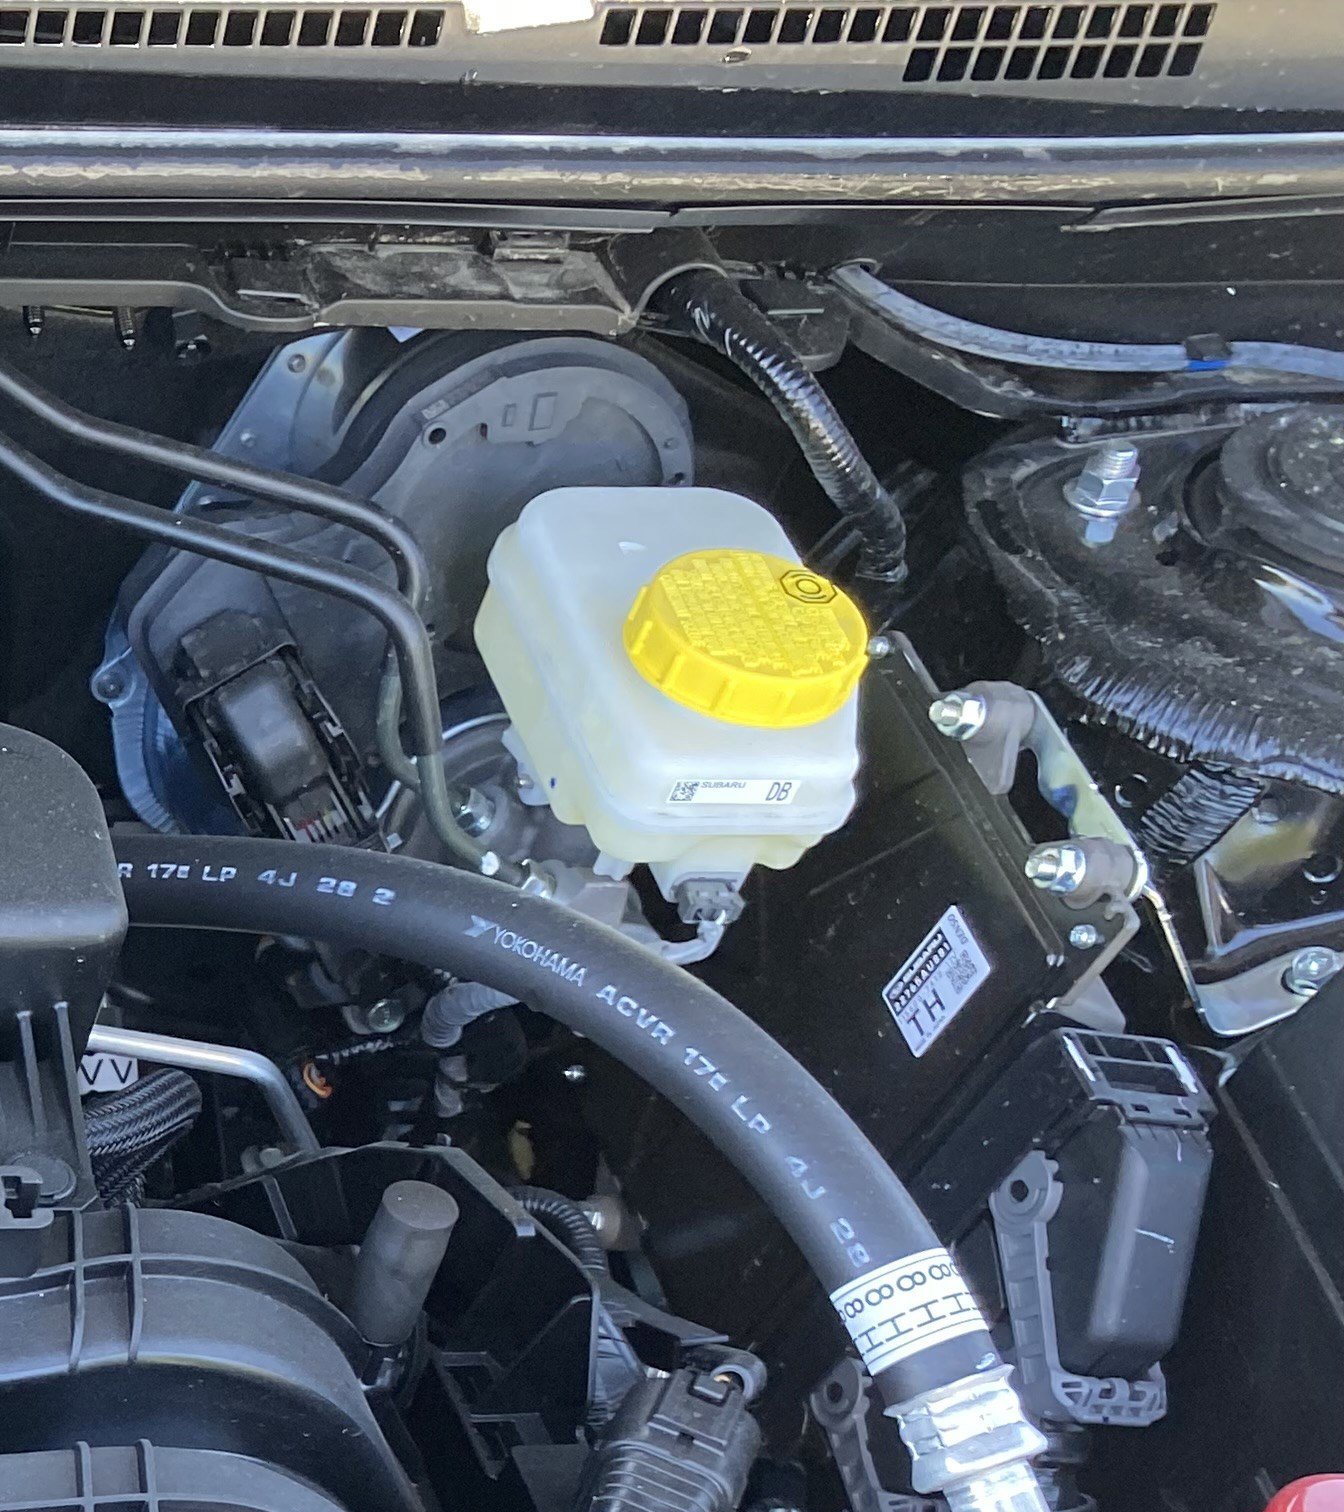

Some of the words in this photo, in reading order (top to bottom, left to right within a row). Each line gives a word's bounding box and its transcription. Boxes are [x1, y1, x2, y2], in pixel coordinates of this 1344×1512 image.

[766, 782, 793, 802] DB
[202, 865, 237, 882] LP
[257, 870, 298, 887] 4J
[316, 877, 358, 898] 28
[906, 988, 945, 1036] TH
[494, 924, 589, 989] YOKOHAMA
[595, 985, 674, 1046] ACVR
[730, 1095, 773, 1135] LP
[784, 1154, 826, 1199] 4J
